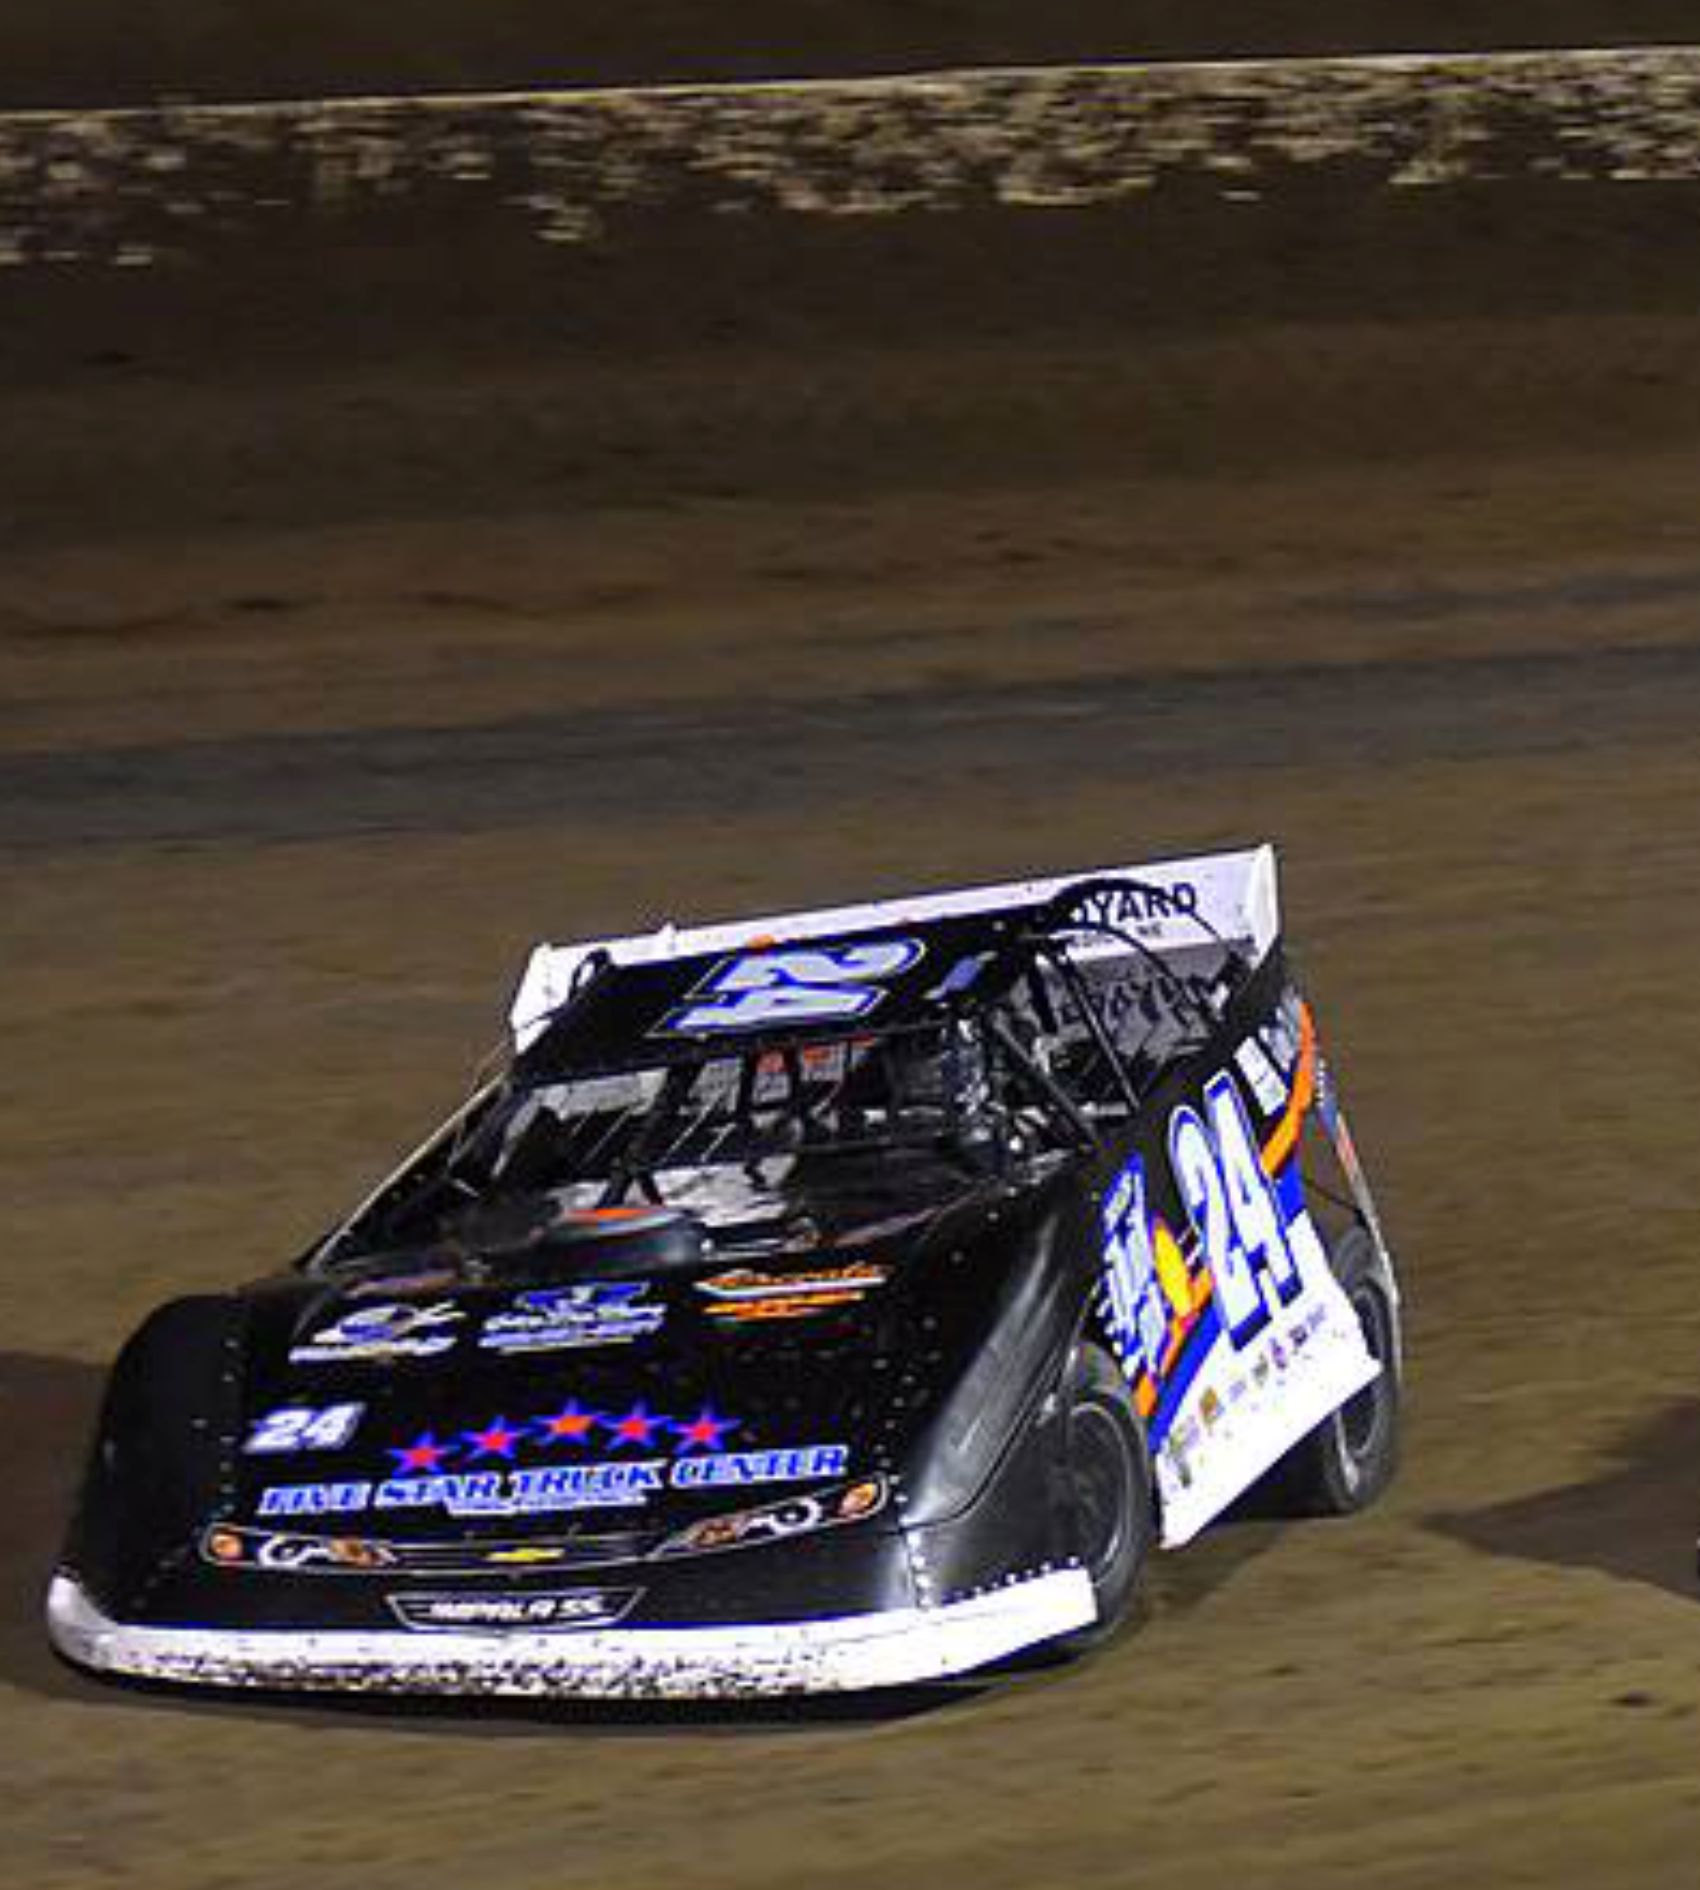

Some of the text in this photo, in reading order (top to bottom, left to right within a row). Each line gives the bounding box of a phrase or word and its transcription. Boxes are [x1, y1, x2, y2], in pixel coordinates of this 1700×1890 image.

[1169, 1068, 1304, 1350] 24
[245, 1402, 366, 1452] 24
[257, 1481, 371, 1516] FIVE
[374, 1471, 502, 1509] STAR
[508, 1459, 668, 1500] TRUCK
[670, 1444, 849, 1488] CENTER
[428, 1596, 556, 1622] IMPALA
